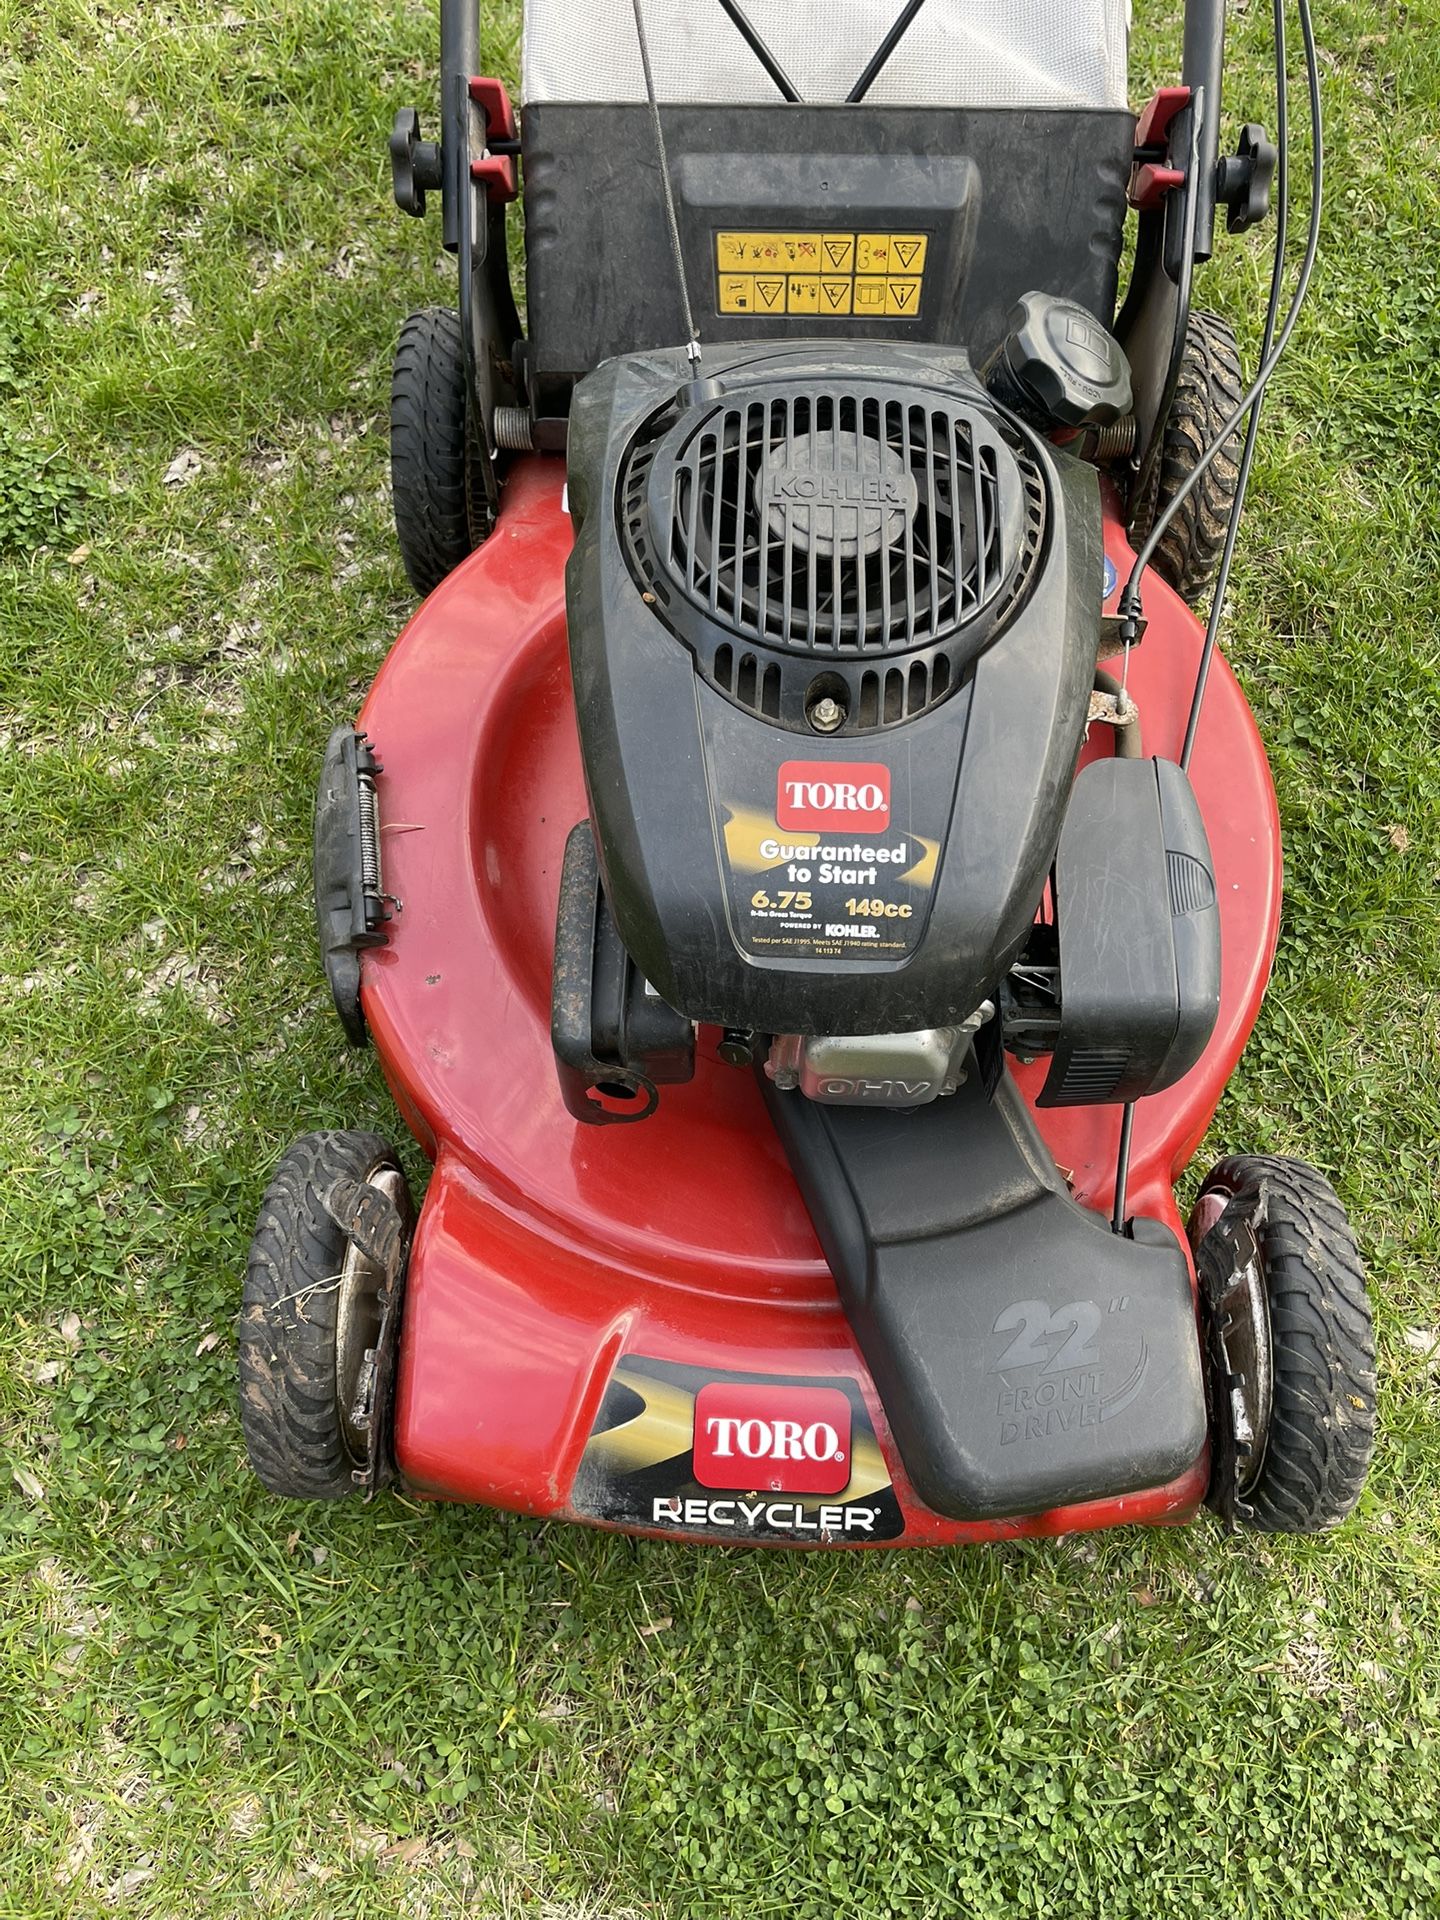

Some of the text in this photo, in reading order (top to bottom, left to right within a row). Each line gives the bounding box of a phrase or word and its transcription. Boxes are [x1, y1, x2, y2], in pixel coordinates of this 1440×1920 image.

[760, 839, 907, 864] Guaranteed
[787, 863, 877, 885] to Start
[751, 890, 912, 918] 6.75 149cc
[789, 911, 812, 920] Torque
[751, 936, 771, 944] Tested
[782, 937, 793, 945] SAE
[812, 938, 831, 946] Meets
[817, 1078, 931, 1097] OHV
[996, 1368, 1104, 1416] FRONT
[1000, 1401, 1102, 1446] DRIVE
